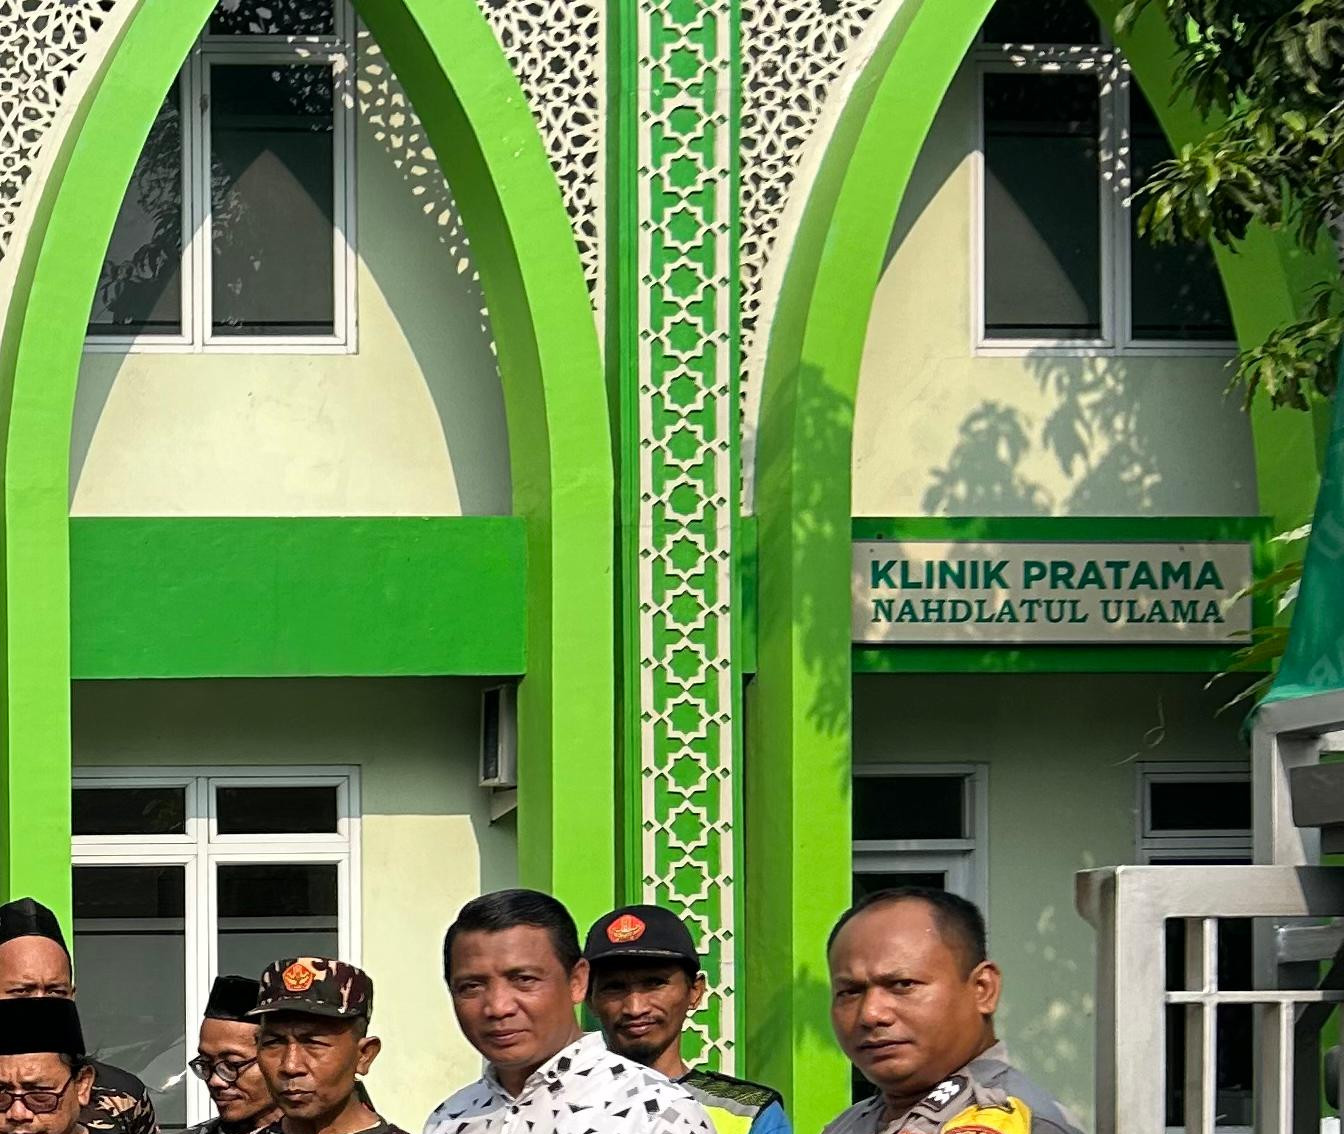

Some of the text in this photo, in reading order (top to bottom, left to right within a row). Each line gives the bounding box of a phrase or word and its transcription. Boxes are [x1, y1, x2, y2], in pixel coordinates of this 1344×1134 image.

[869, 560, 1225, 590] KLINIK PRATAMA
[870, 598, 1226, 624] NAHDLATUL ULAMA
